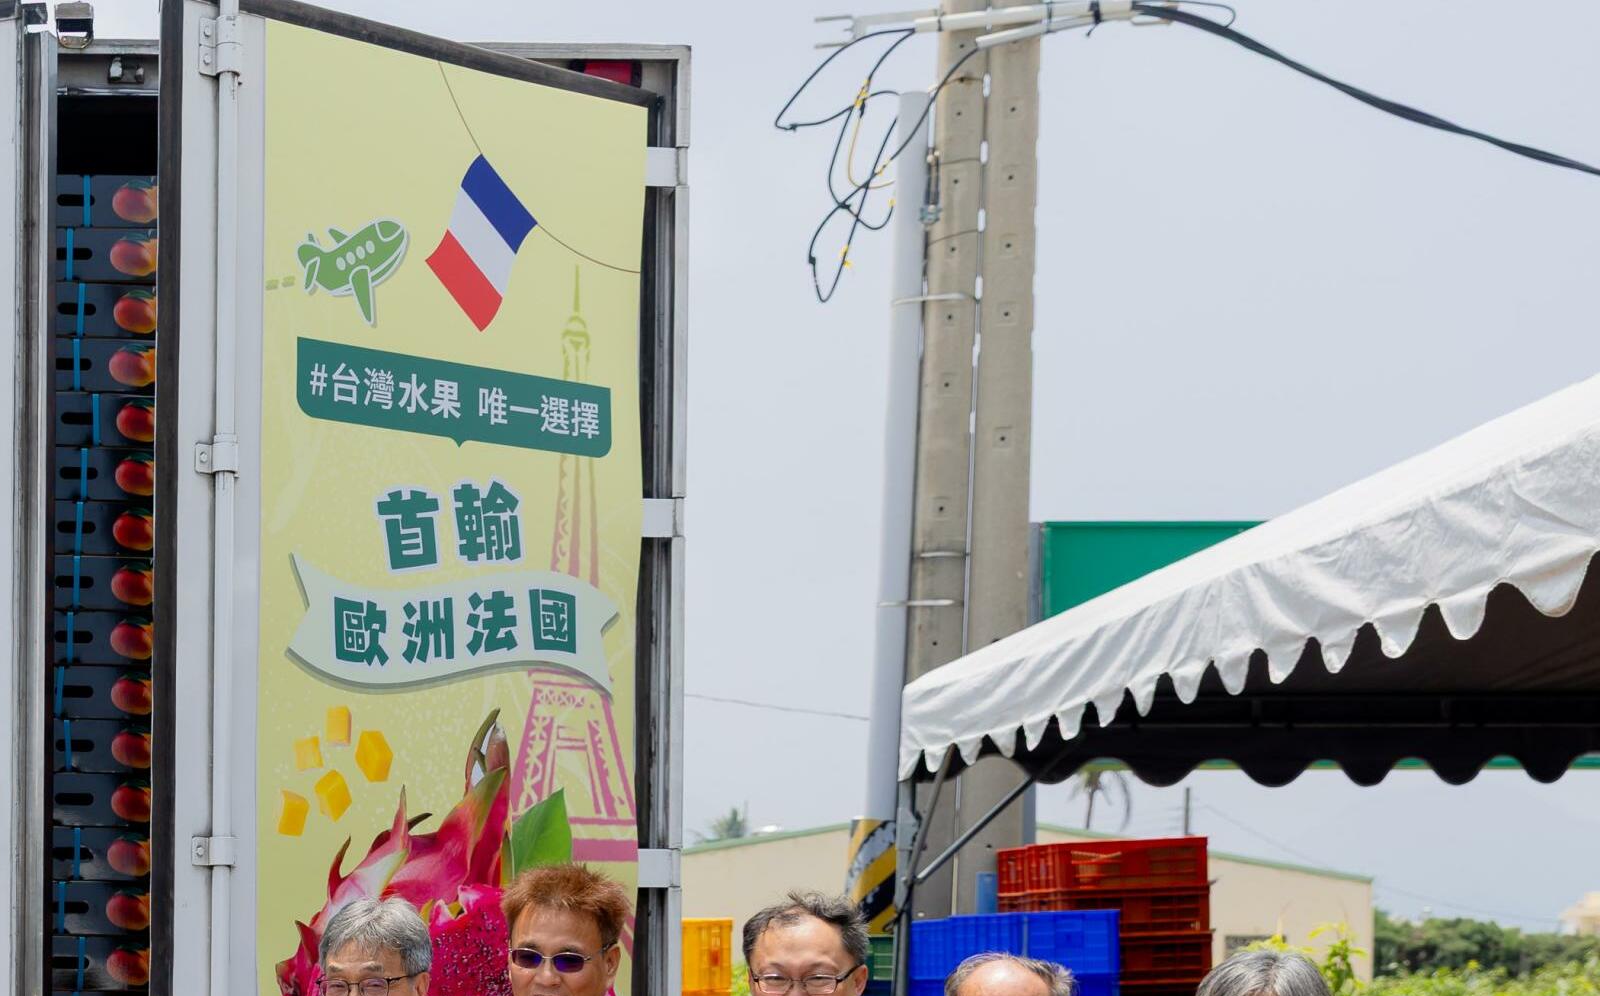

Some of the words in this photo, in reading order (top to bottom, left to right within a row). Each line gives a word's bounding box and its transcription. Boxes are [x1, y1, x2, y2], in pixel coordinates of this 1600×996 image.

[309, 362, 462, 420] #台灣水果
[477, 386, 601, 440] 唯一選擇
[376, 480, 522, 571] 首輸
[333, 587, 577, 667] 歐洲法國
